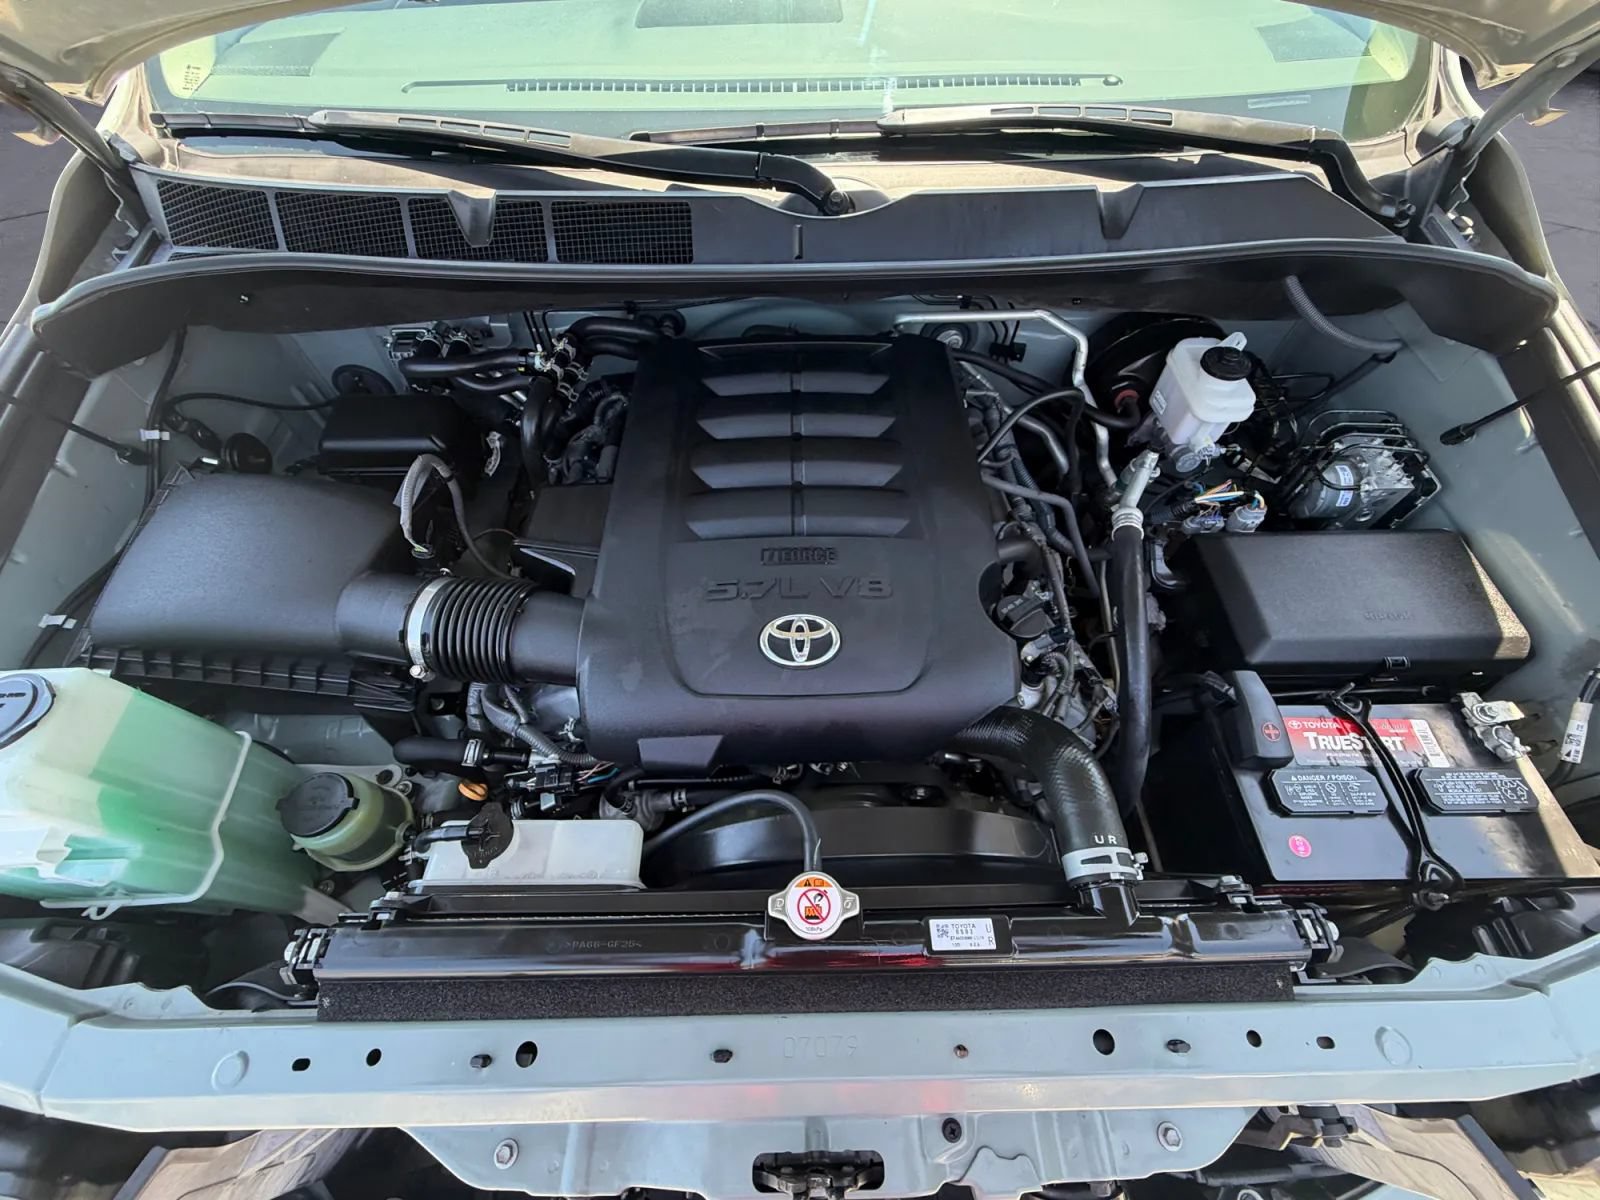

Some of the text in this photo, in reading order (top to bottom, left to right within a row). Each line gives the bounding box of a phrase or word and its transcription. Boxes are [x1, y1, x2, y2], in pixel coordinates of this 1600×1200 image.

[819, 576, 893, 599] V8
[1303, 721, 1340, 729] TOYOTA
[1303, 732, 1405, 752] TRUESTRT
